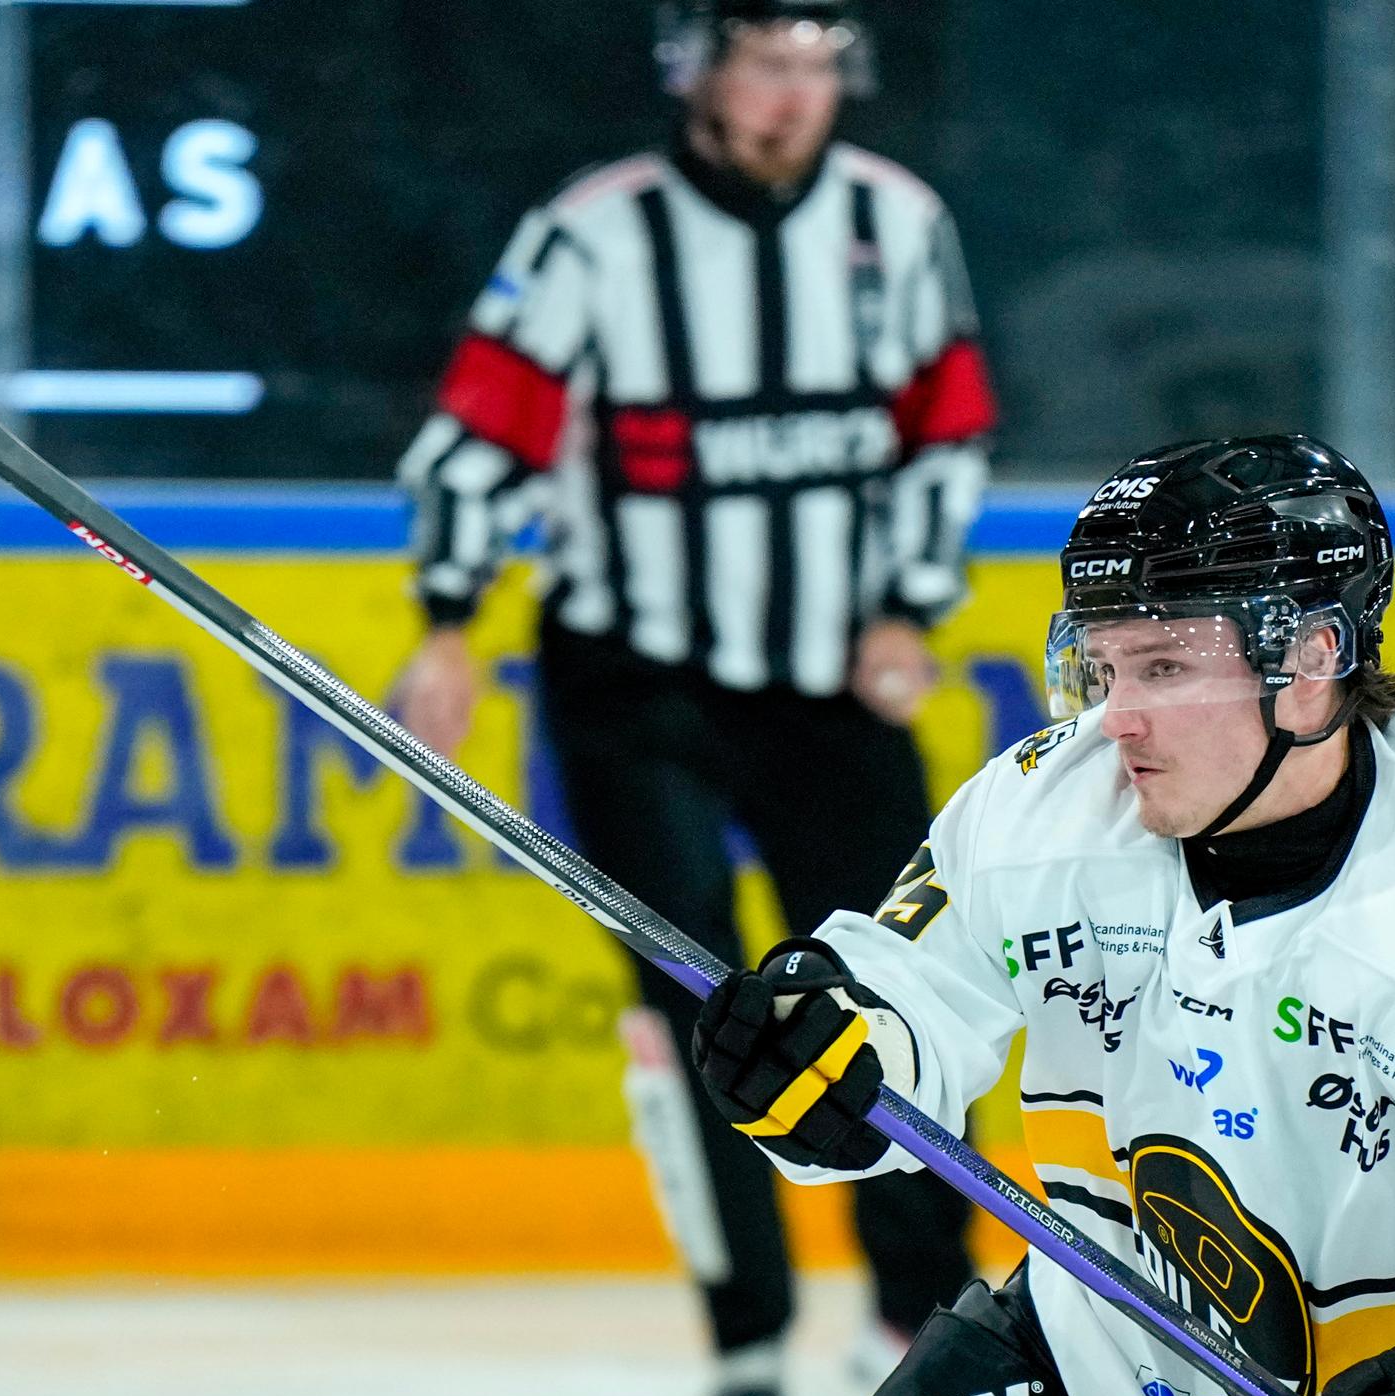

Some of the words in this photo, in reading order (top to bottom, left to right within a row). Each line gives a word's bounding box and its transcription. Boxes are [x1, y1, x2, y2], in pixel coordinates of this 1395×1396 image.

[38, 117, 266, 250] AS
[1093, 476, 1161, 502] CMS
[1316, 544, 1364, 565] CCM
[1070, 557, 1133, 581] CCM
[1264, 675, 1294, 686] CCM
[1272, 996, 1355, 1054] SFF
[997, 1177, 1075, 1244] TRIGGER
